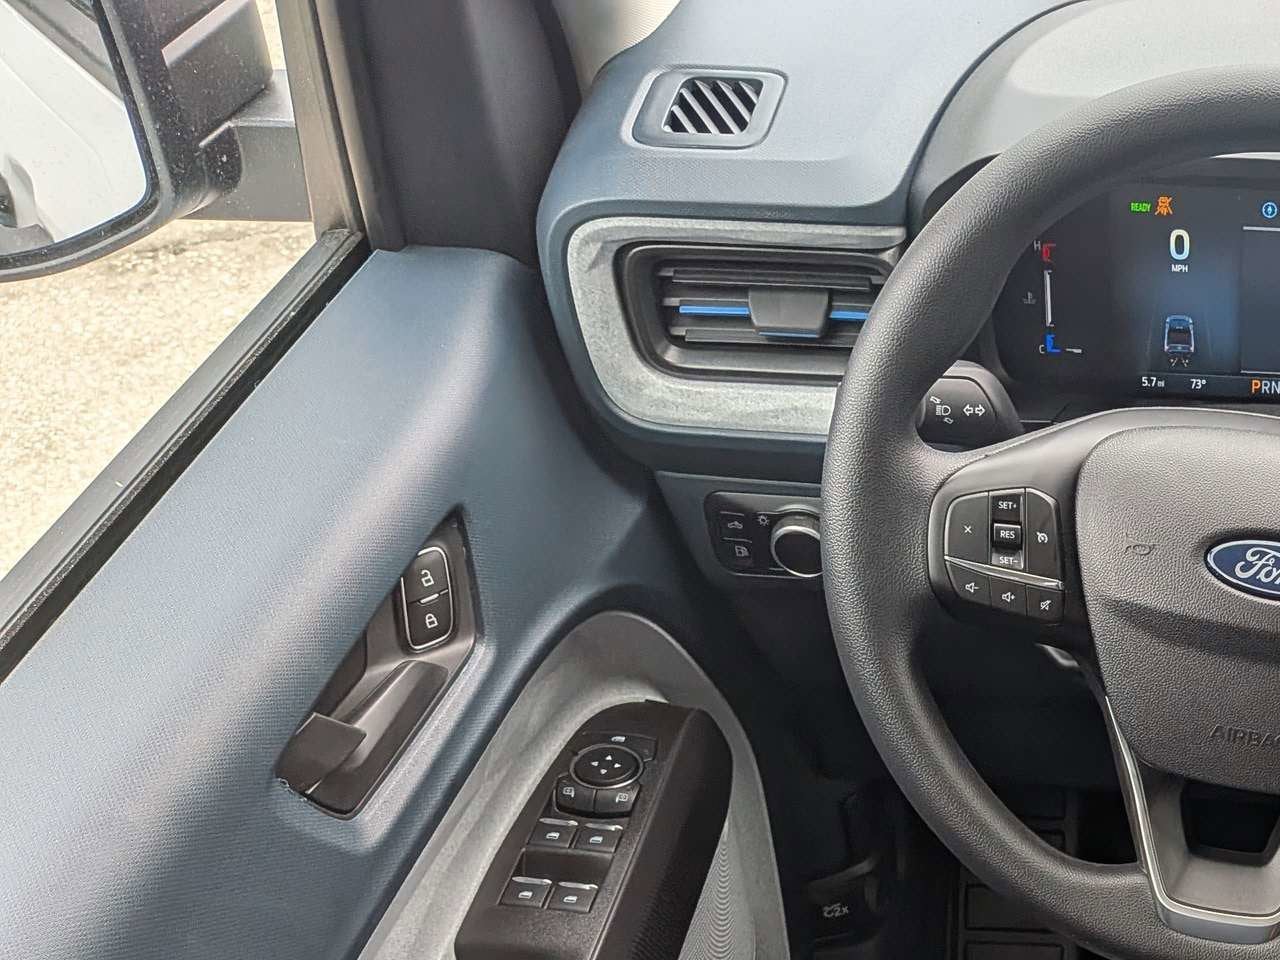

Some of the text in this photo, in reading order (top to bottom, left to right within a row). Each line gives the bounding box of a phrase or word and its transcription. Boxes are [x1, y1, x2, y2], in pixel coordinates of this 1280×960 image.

[1131, 202, 1151, 212] READY
[1033, 240, 1041, 251] H
[1169, 229, 1190, 260] 0
[1171, 264, 1188, 273] MPH
[1141, 376, 1157, 387] 5.7
[1000, 530, 1015, 539] RES
